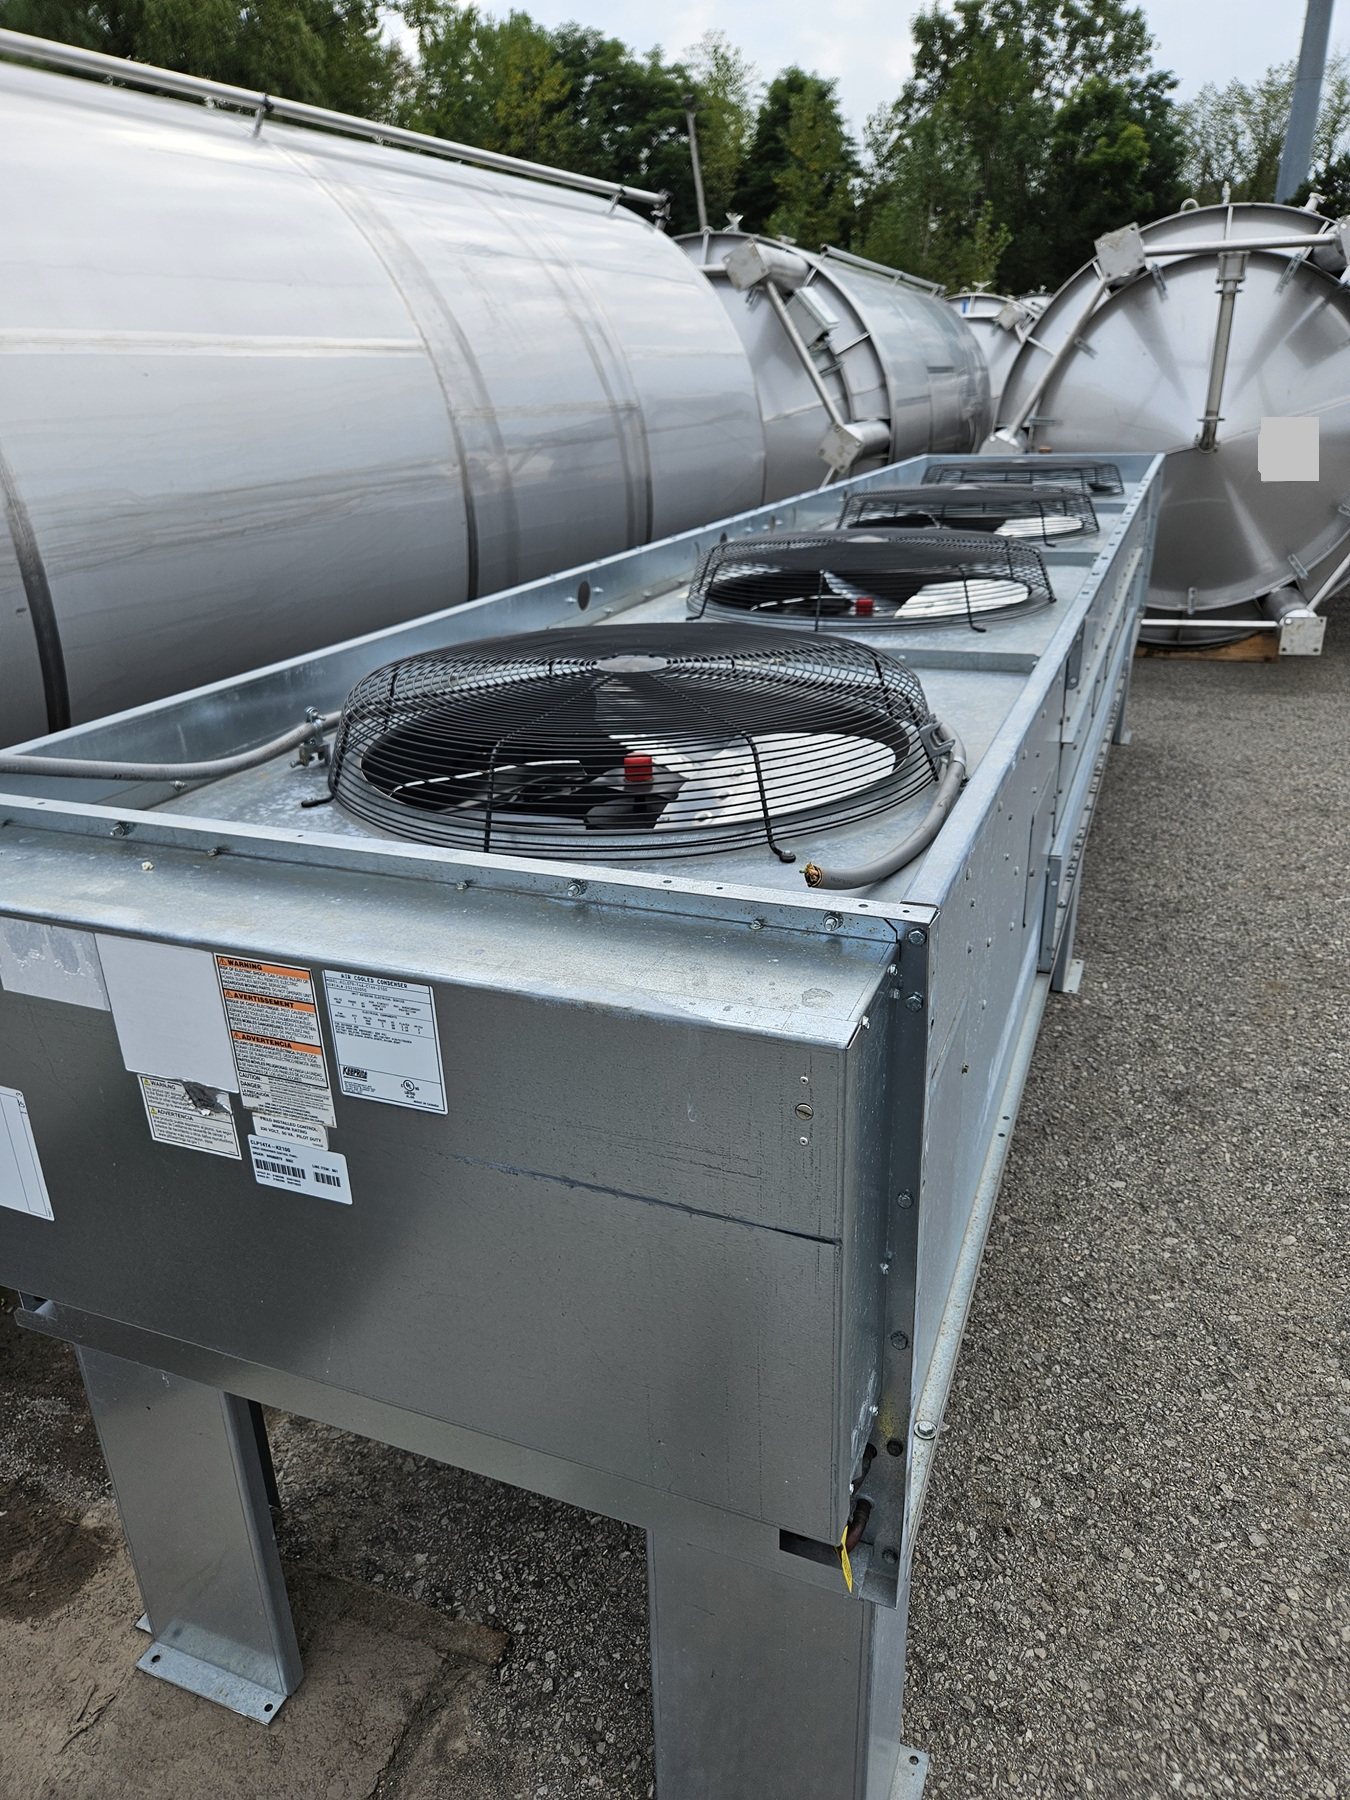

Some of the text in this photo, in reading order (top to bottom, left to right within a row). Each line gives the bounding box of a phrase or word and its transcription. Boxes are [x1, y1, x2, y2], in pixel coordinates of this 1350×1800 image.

[228, 960, 262, 971] WARNING
[354, 976, 374, 984] COOLED
[377, 980, 408, 989] CONDENSER
[234, 993, 295, 1009] AVERTISSEMENT
[241, 1034, 292, 1049] ADVERTENCIA
[151, 1081, 176, 1089] WARNING
[158, 1110, 193, 1121] ADVERTENCIA
[273, 1119, 296, 1127] INSTALLED
